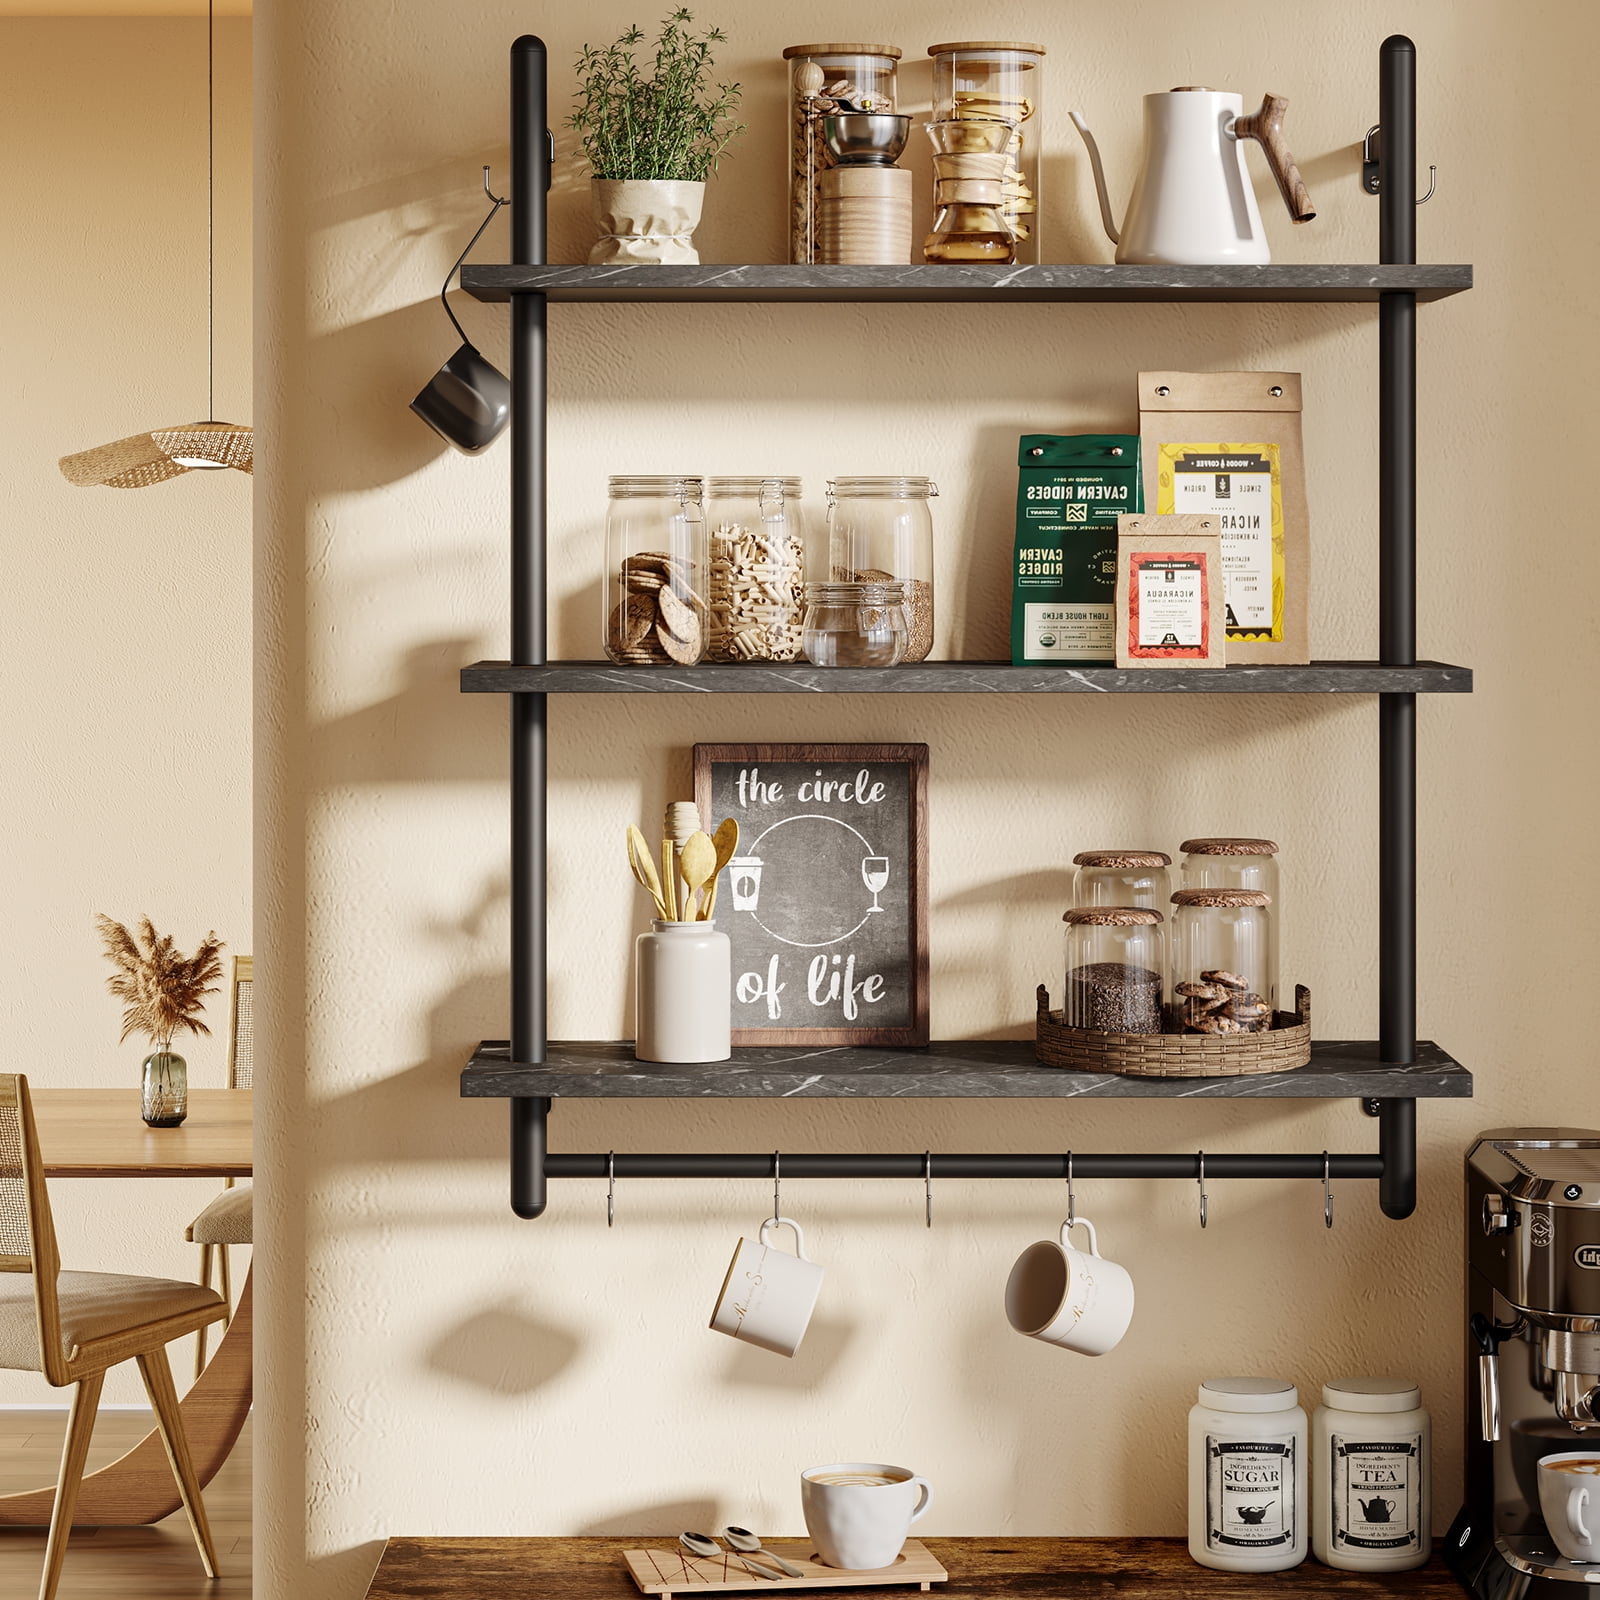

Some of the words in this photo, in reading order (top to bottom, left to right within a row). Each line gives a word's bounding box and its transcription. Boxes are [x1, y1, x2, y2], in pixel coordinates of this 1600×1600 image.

[735, 768, 784, 808] the
[797, 768, 887, 805] circle
[736, 954, 787, 1020] of
[807, 954, 886, 1021] life
[1224, 1469, 1279, 1483] SUGAR
[1359, 1470, 1397, 1482] TEA
